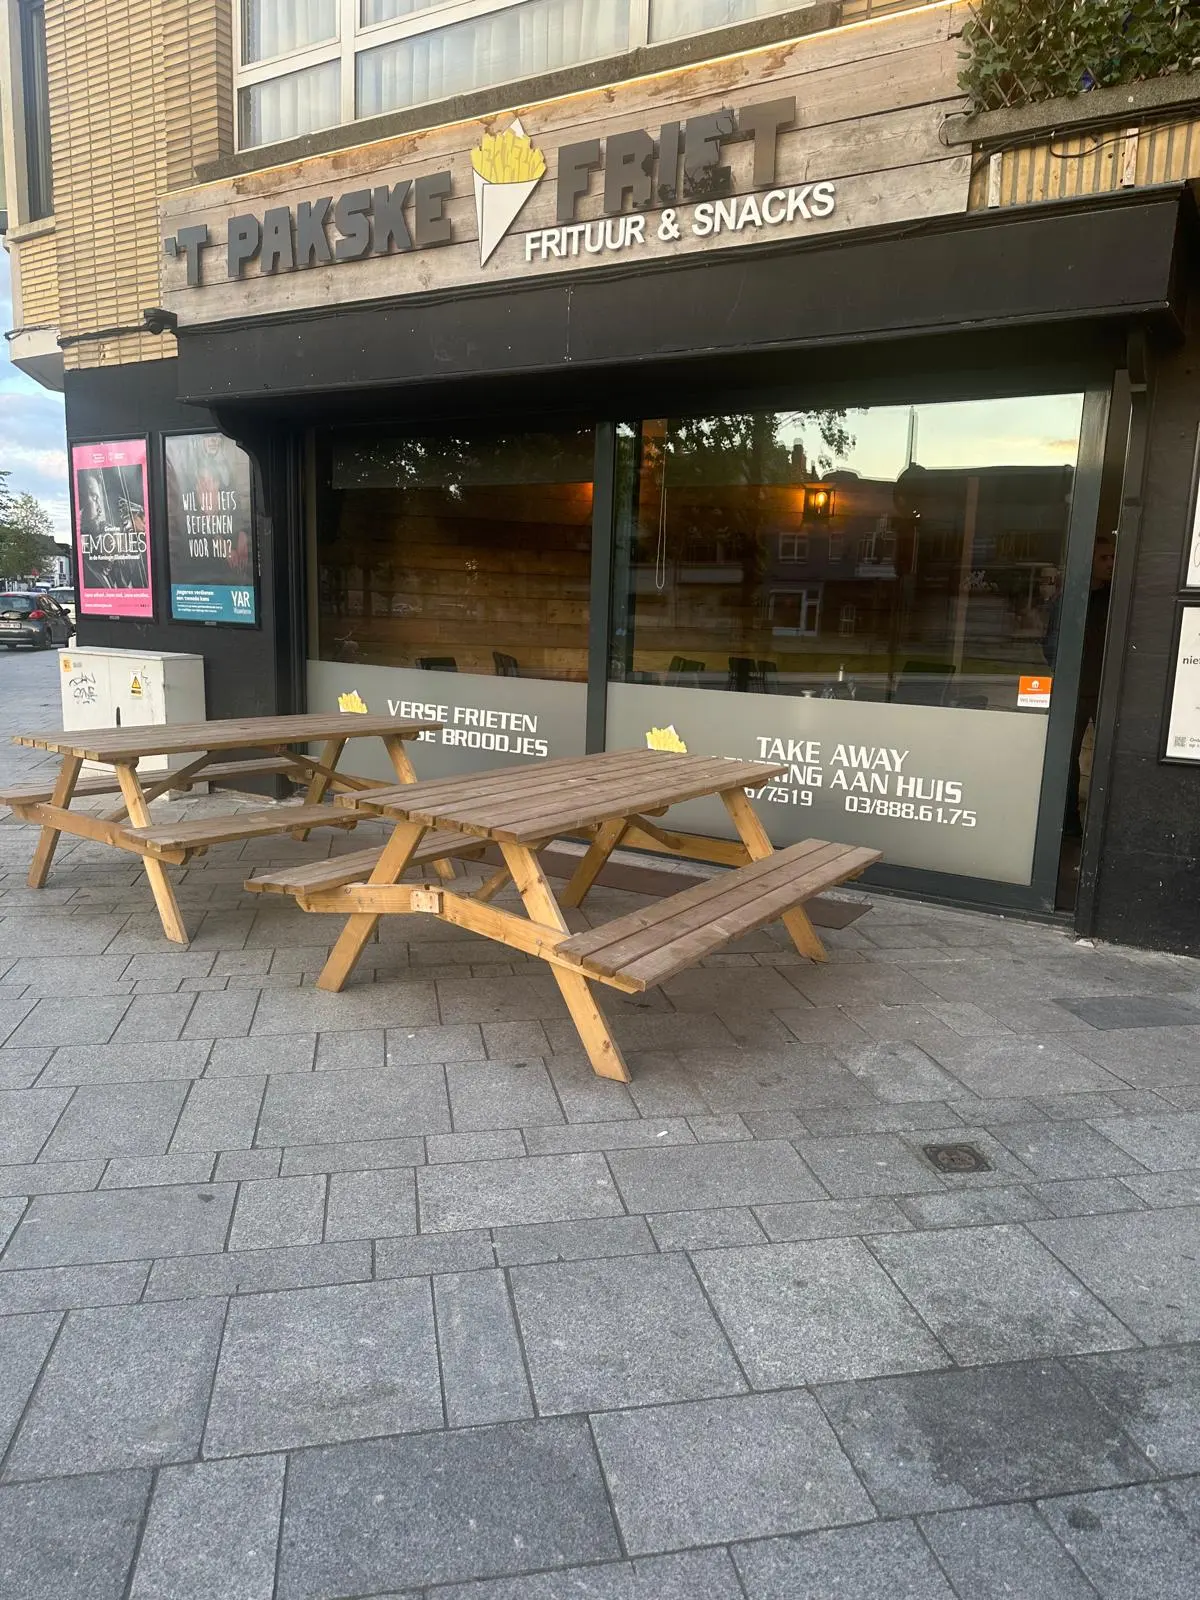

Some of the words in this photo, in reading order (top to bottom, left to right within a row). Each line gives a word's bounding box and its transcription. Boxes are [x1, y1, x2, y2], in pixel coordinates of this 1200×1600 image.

[228, 170, 452, 278] PAKSKE
[556, 96, 796, 221] FRIET
[525, 214, 645, 261] FRITUUR
[657, 208, 680, 242] &
[692, 182, 836, 236] SNACKS
[182, 493, 198, 511] WIL
[200, 492, 213, 511] JIJ
[217, 490, 237, 510] IETS
[186, 515, 233, 535] BETEKENEN
[81, 532, 147, 554] EMOTIES
[188, 539, 208, 558] VOOR
[212, 539, 232, 558] MIJ?
[230, 590, 250, 607] YAR
[387, 699, 448, 723] VERSE
[453, 706, 538, 733] FRIETEN
[442, 728, 548, 757] BROODJES
[756, 736, 821, 764] TAKE
[829, 743, 909, 772] AWAY
[830, 770, 889, 795] AAN
[896, 775, 963, 804] HUIS
[845, 795, 977, 827] 03/888.61.75
